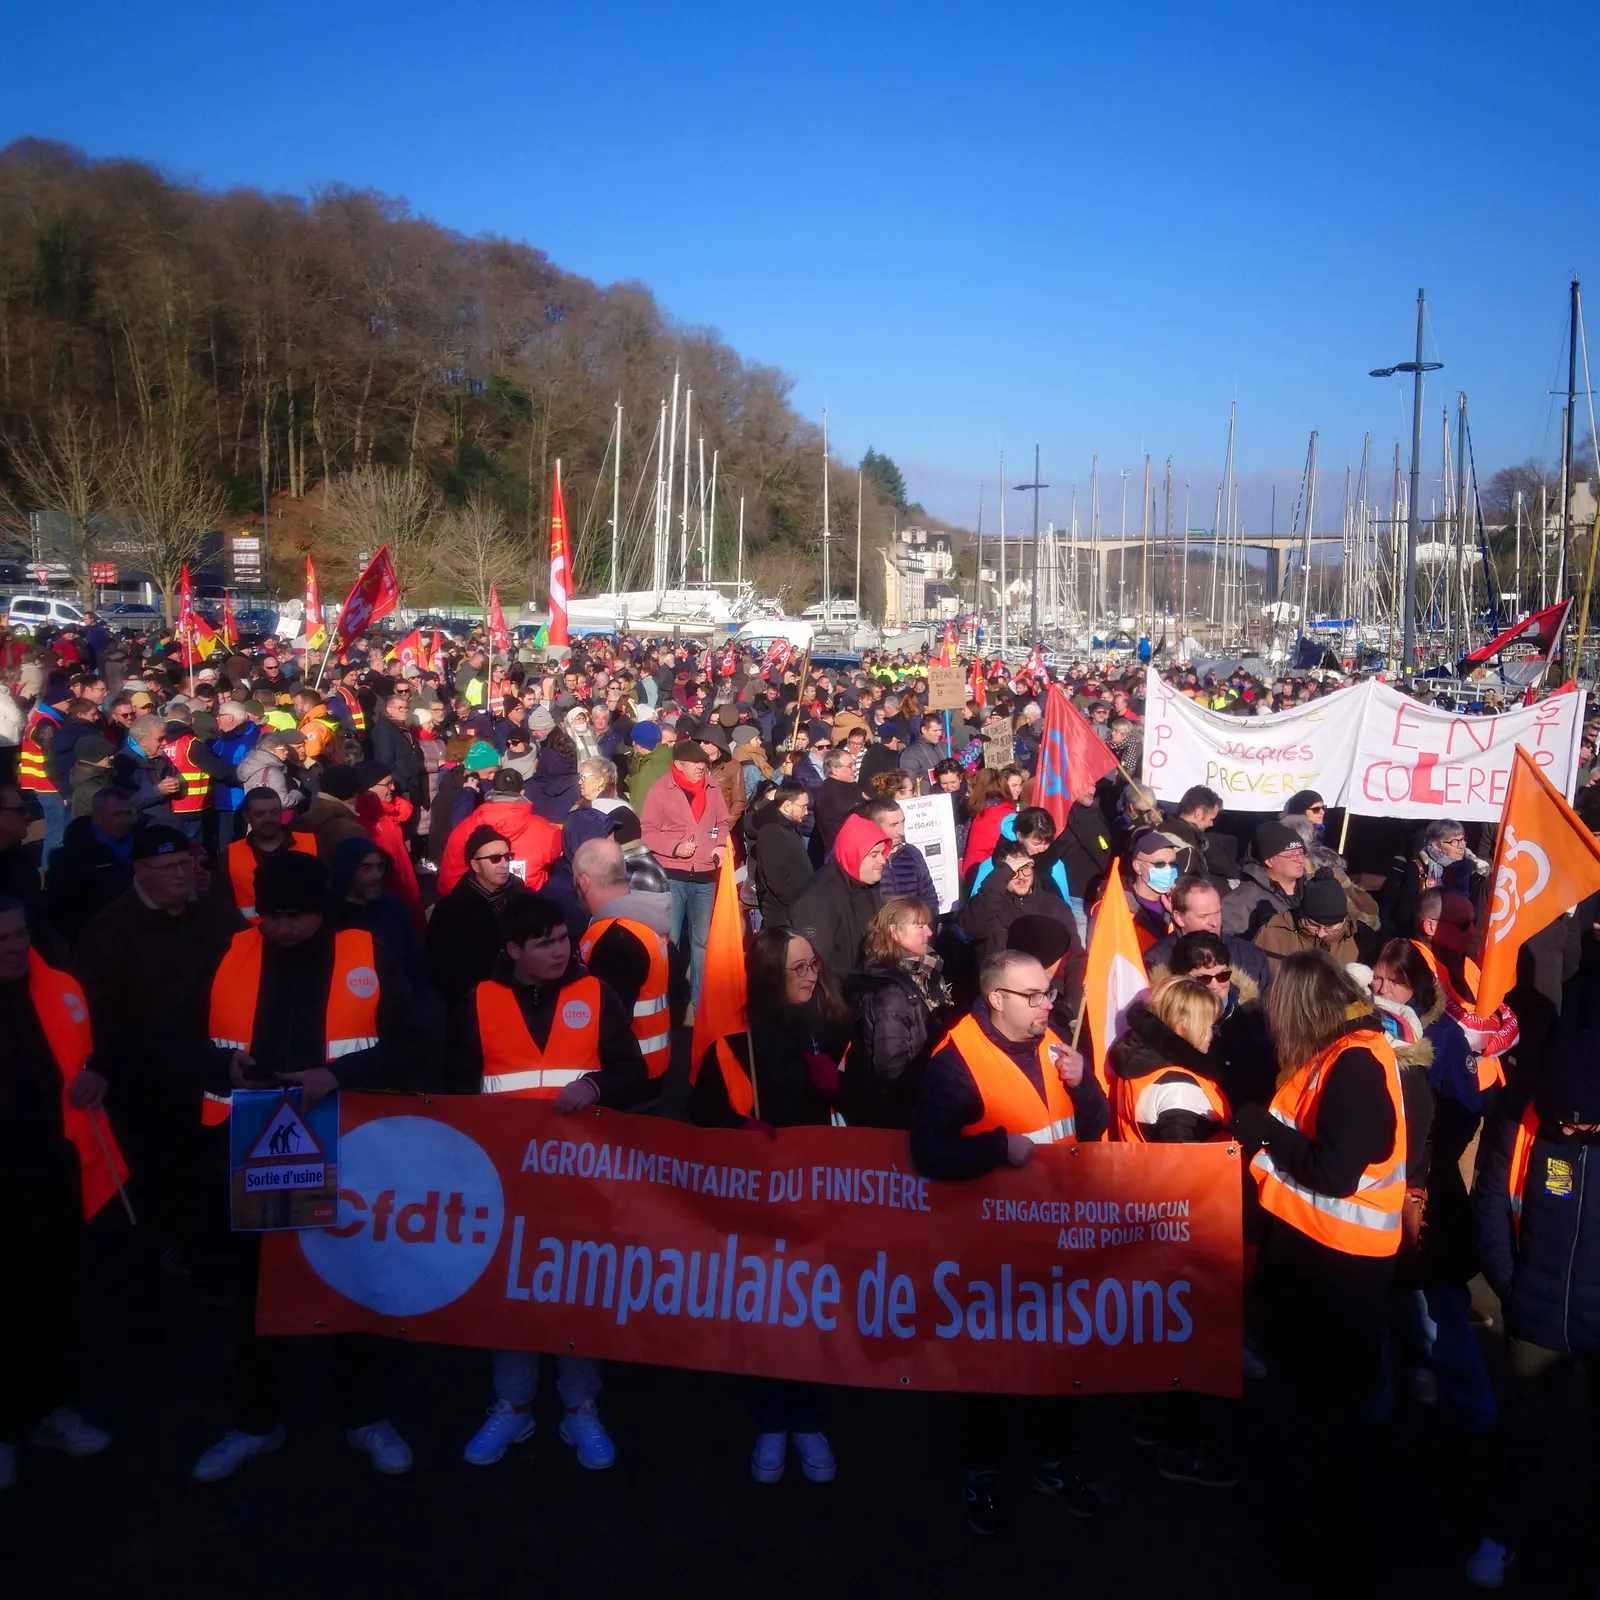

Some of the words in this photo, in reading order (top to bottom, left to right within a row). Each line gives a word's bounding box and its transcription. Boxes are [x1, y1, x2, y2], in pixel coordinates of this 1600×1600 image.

[1391, 702, 1497, 755] EN
[1216, 740, 1315, 767] JACQUES
[1205, 760, 1321, 795] PREVERT
[564, 1010, 589, 1019] Cfdt:
[247, 1171, 280, 1187] Sortie
[282, 1169, 323, 1185] d'usine
[521, 1138, 763, 1202] AGROALIMENTAIRE
[767, 1167, 804, 1203] DU
[811, 1163, 932, 1212] FINISTÈRE
[981, 1197, 1071, 1224] S'ENGAGER
[1074, 1200, 1121, 1225] POUR
[1124, 1199, 1190, 1223] CHACUN
[1057, 1227, 1096, 1249] AGIR
[1100, 1225, 1144, 1248] POUR
[1149, 1221, 1191, 1242] TOUS
[505, 1214, 841, 1332] Lampaulaise
[856, 1250, 917, 1339] de
[932, 1260, 1193, 1346] Salaisons
